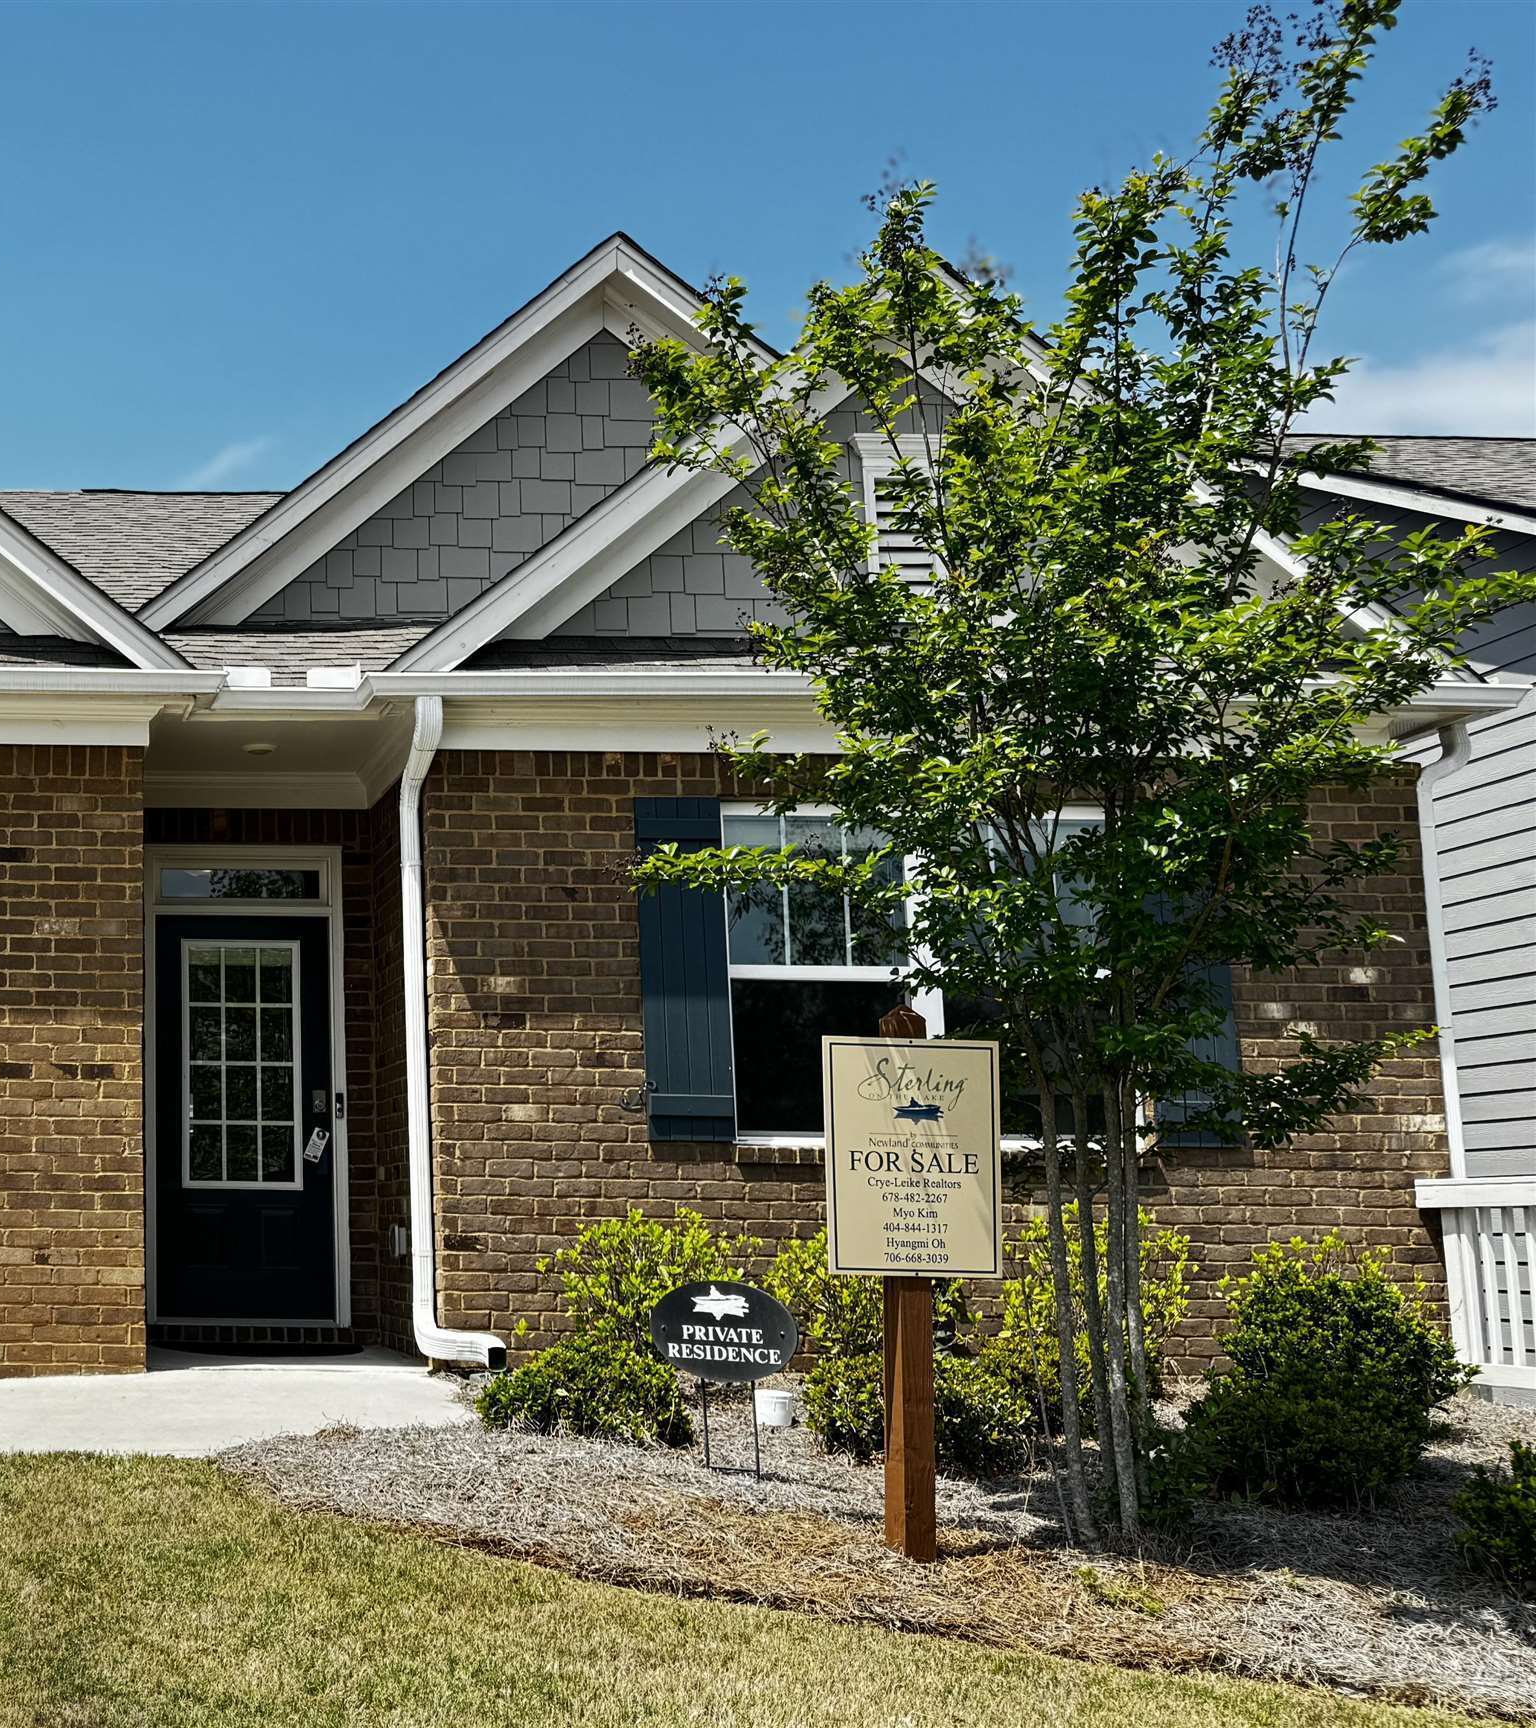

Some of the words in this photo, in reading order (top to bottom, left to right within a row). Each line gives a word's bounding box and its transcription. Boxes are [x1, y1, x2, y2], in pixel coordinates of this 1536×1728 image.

[857, 1058, 966, 1111] Sterling
[869, 1138, 909, 1149] Newland
[849, 1150, 903, 1172] FOR
[911, 1151, 980, 1174] SALE
[867, 1177, 921, 1189] Crye-Leike
[923, 1178, 962, 1189] Realtors
[882, 1193, 948, 1203] 678-482-2267
[893, 1208, 915, 1220] Myo
[918, 1208, 938, 1218] Kim
[883, 1223, 948, 1234] 404-844-1317
[886, 1237, 929, 1250] Hyangmi
[931, 1238, 946, 1249] Oh
[884, 1252, 949, 1263] 706-668-3039
[681, 1324, 764, 1345] PRIVATE
[667, 1342, 782, 1365] RESIDENCE
